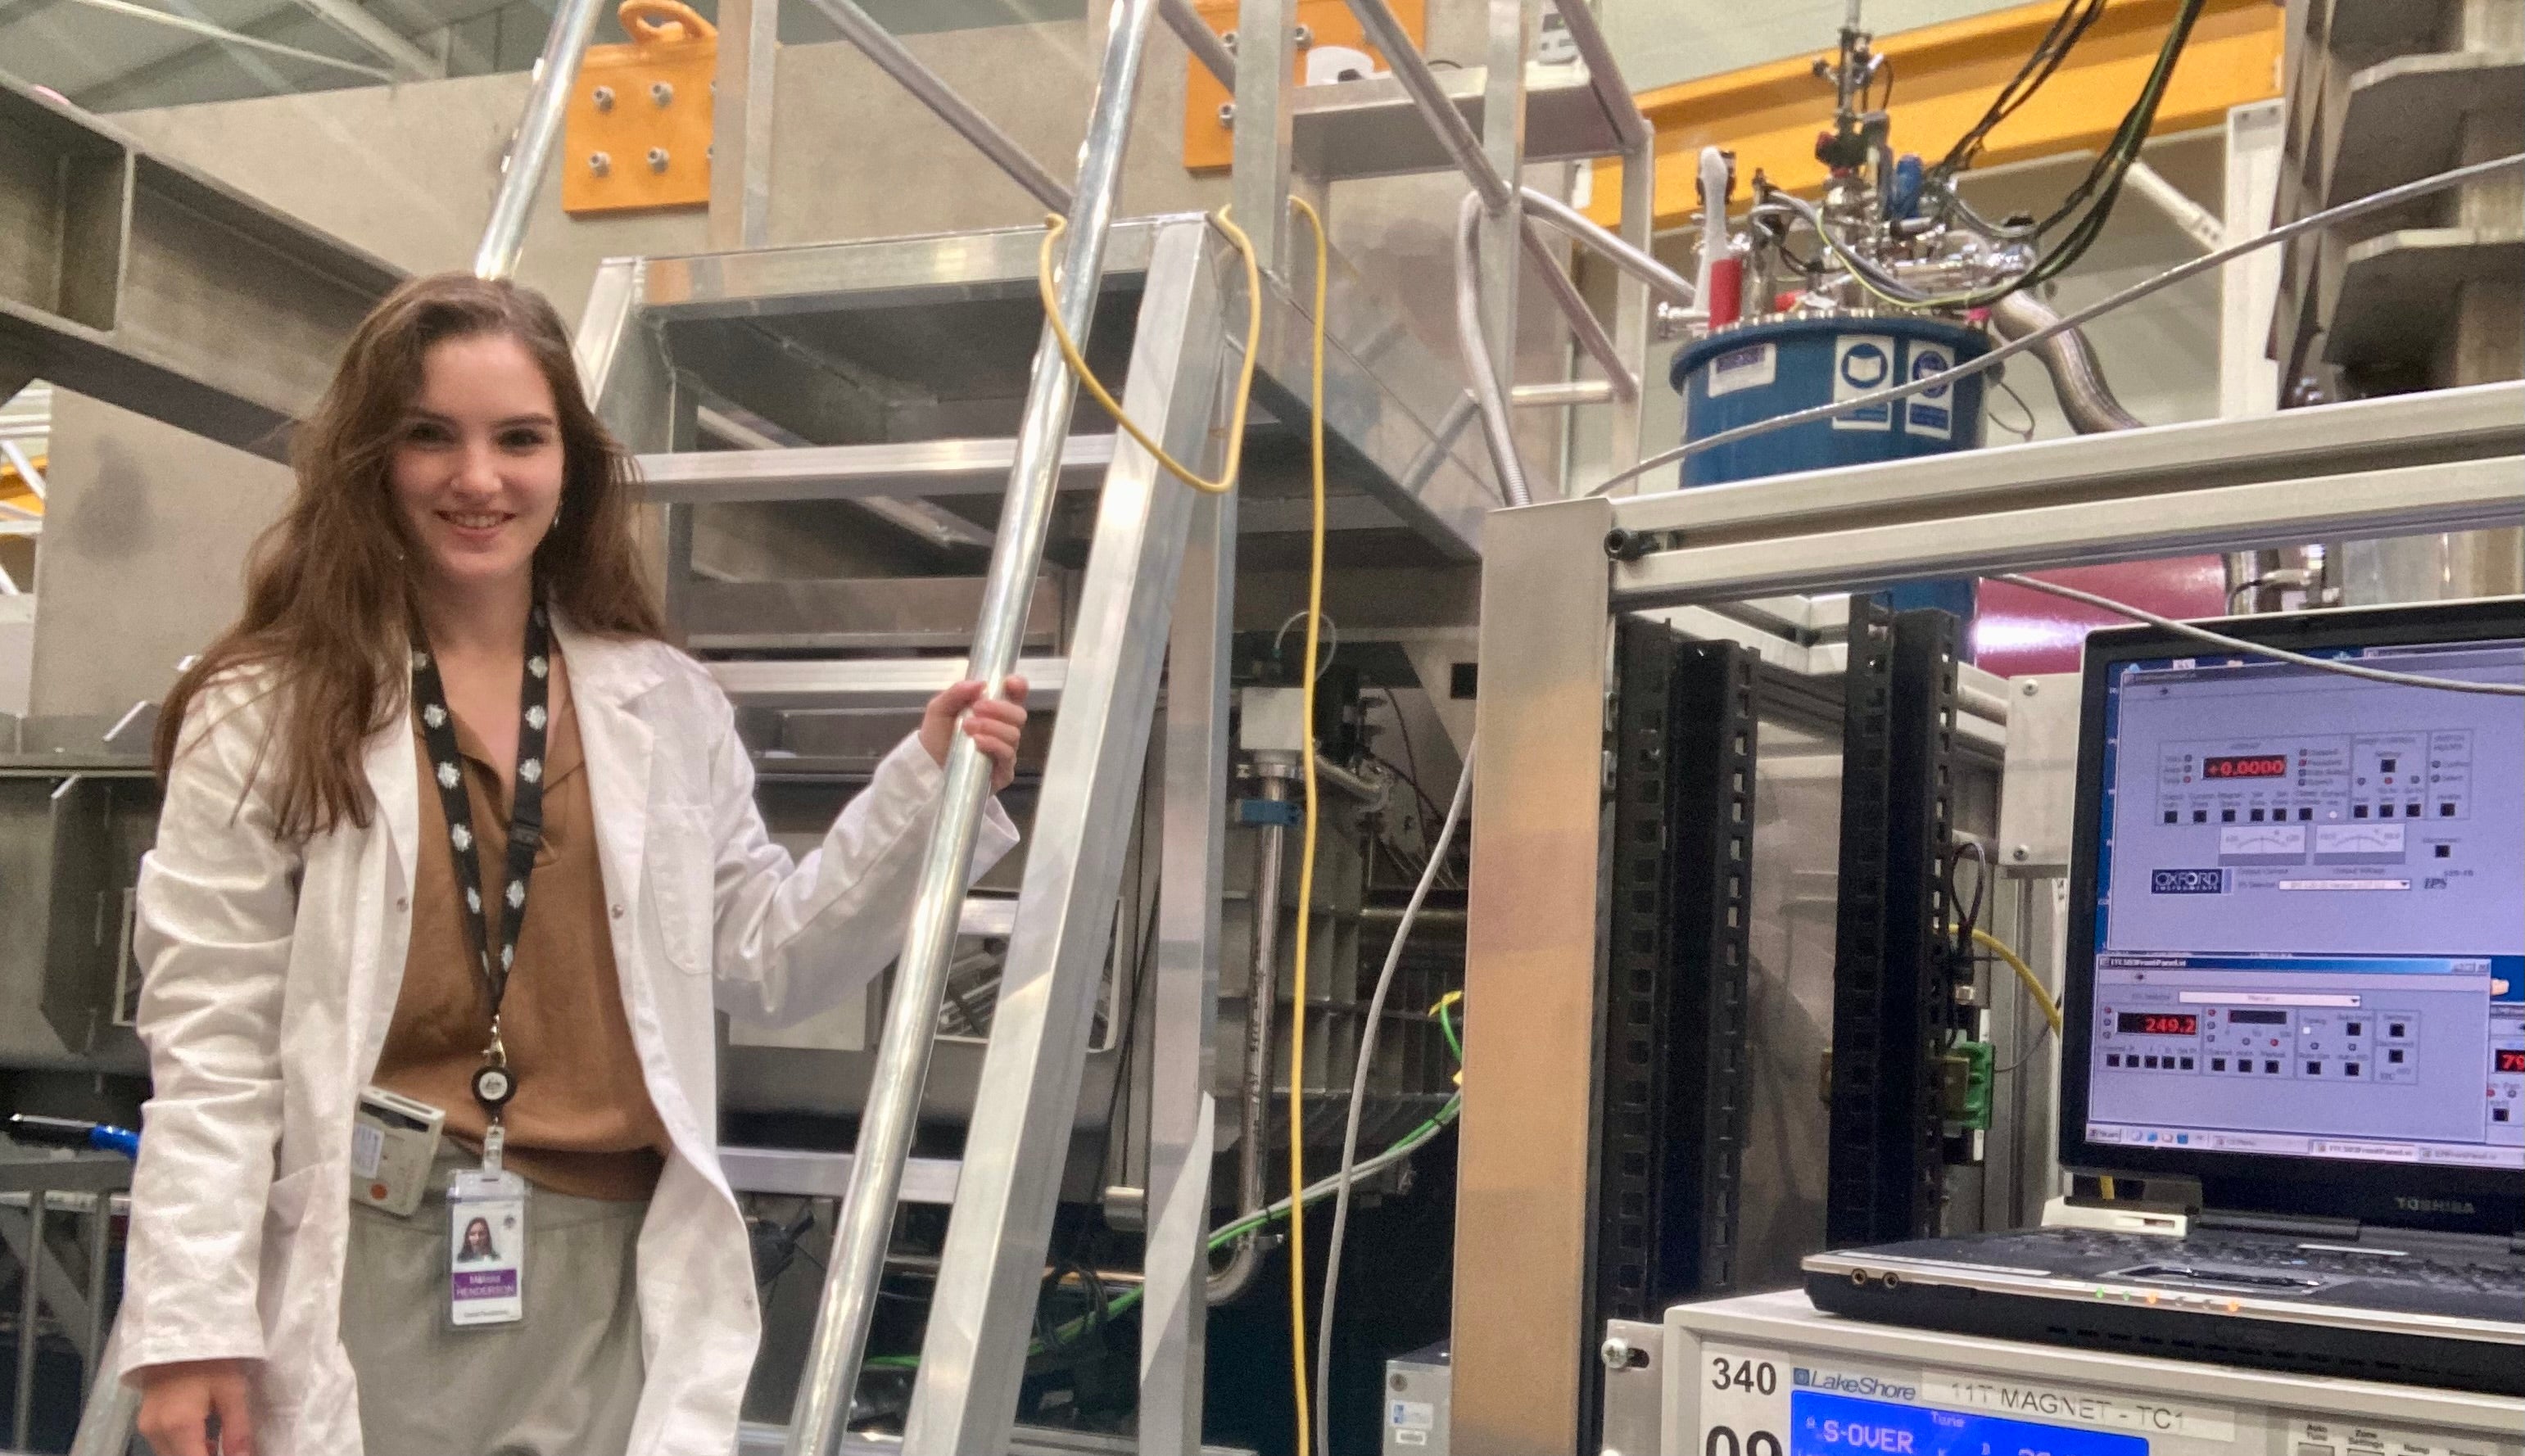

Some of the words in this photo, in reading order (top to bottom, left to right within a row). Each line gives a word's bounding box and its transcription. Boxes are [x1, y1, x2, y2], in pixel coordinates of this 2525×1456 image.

[2156, 872, 2219, 886] OXFORD
[2144, 1016, 2197, 1034] 249.2
[2395, 1196, 2474, 1214] TOSHIBA
[1712, 1357, 1777, 1396] 340
[1812, 1370, 1916, 1400] LakeShore
[2001, 1388, 2111, 1421] MAGNET
[2136, 1404, 2186, 1430] TC1
[1823, 1419, 1915, 1455] S-OVER
